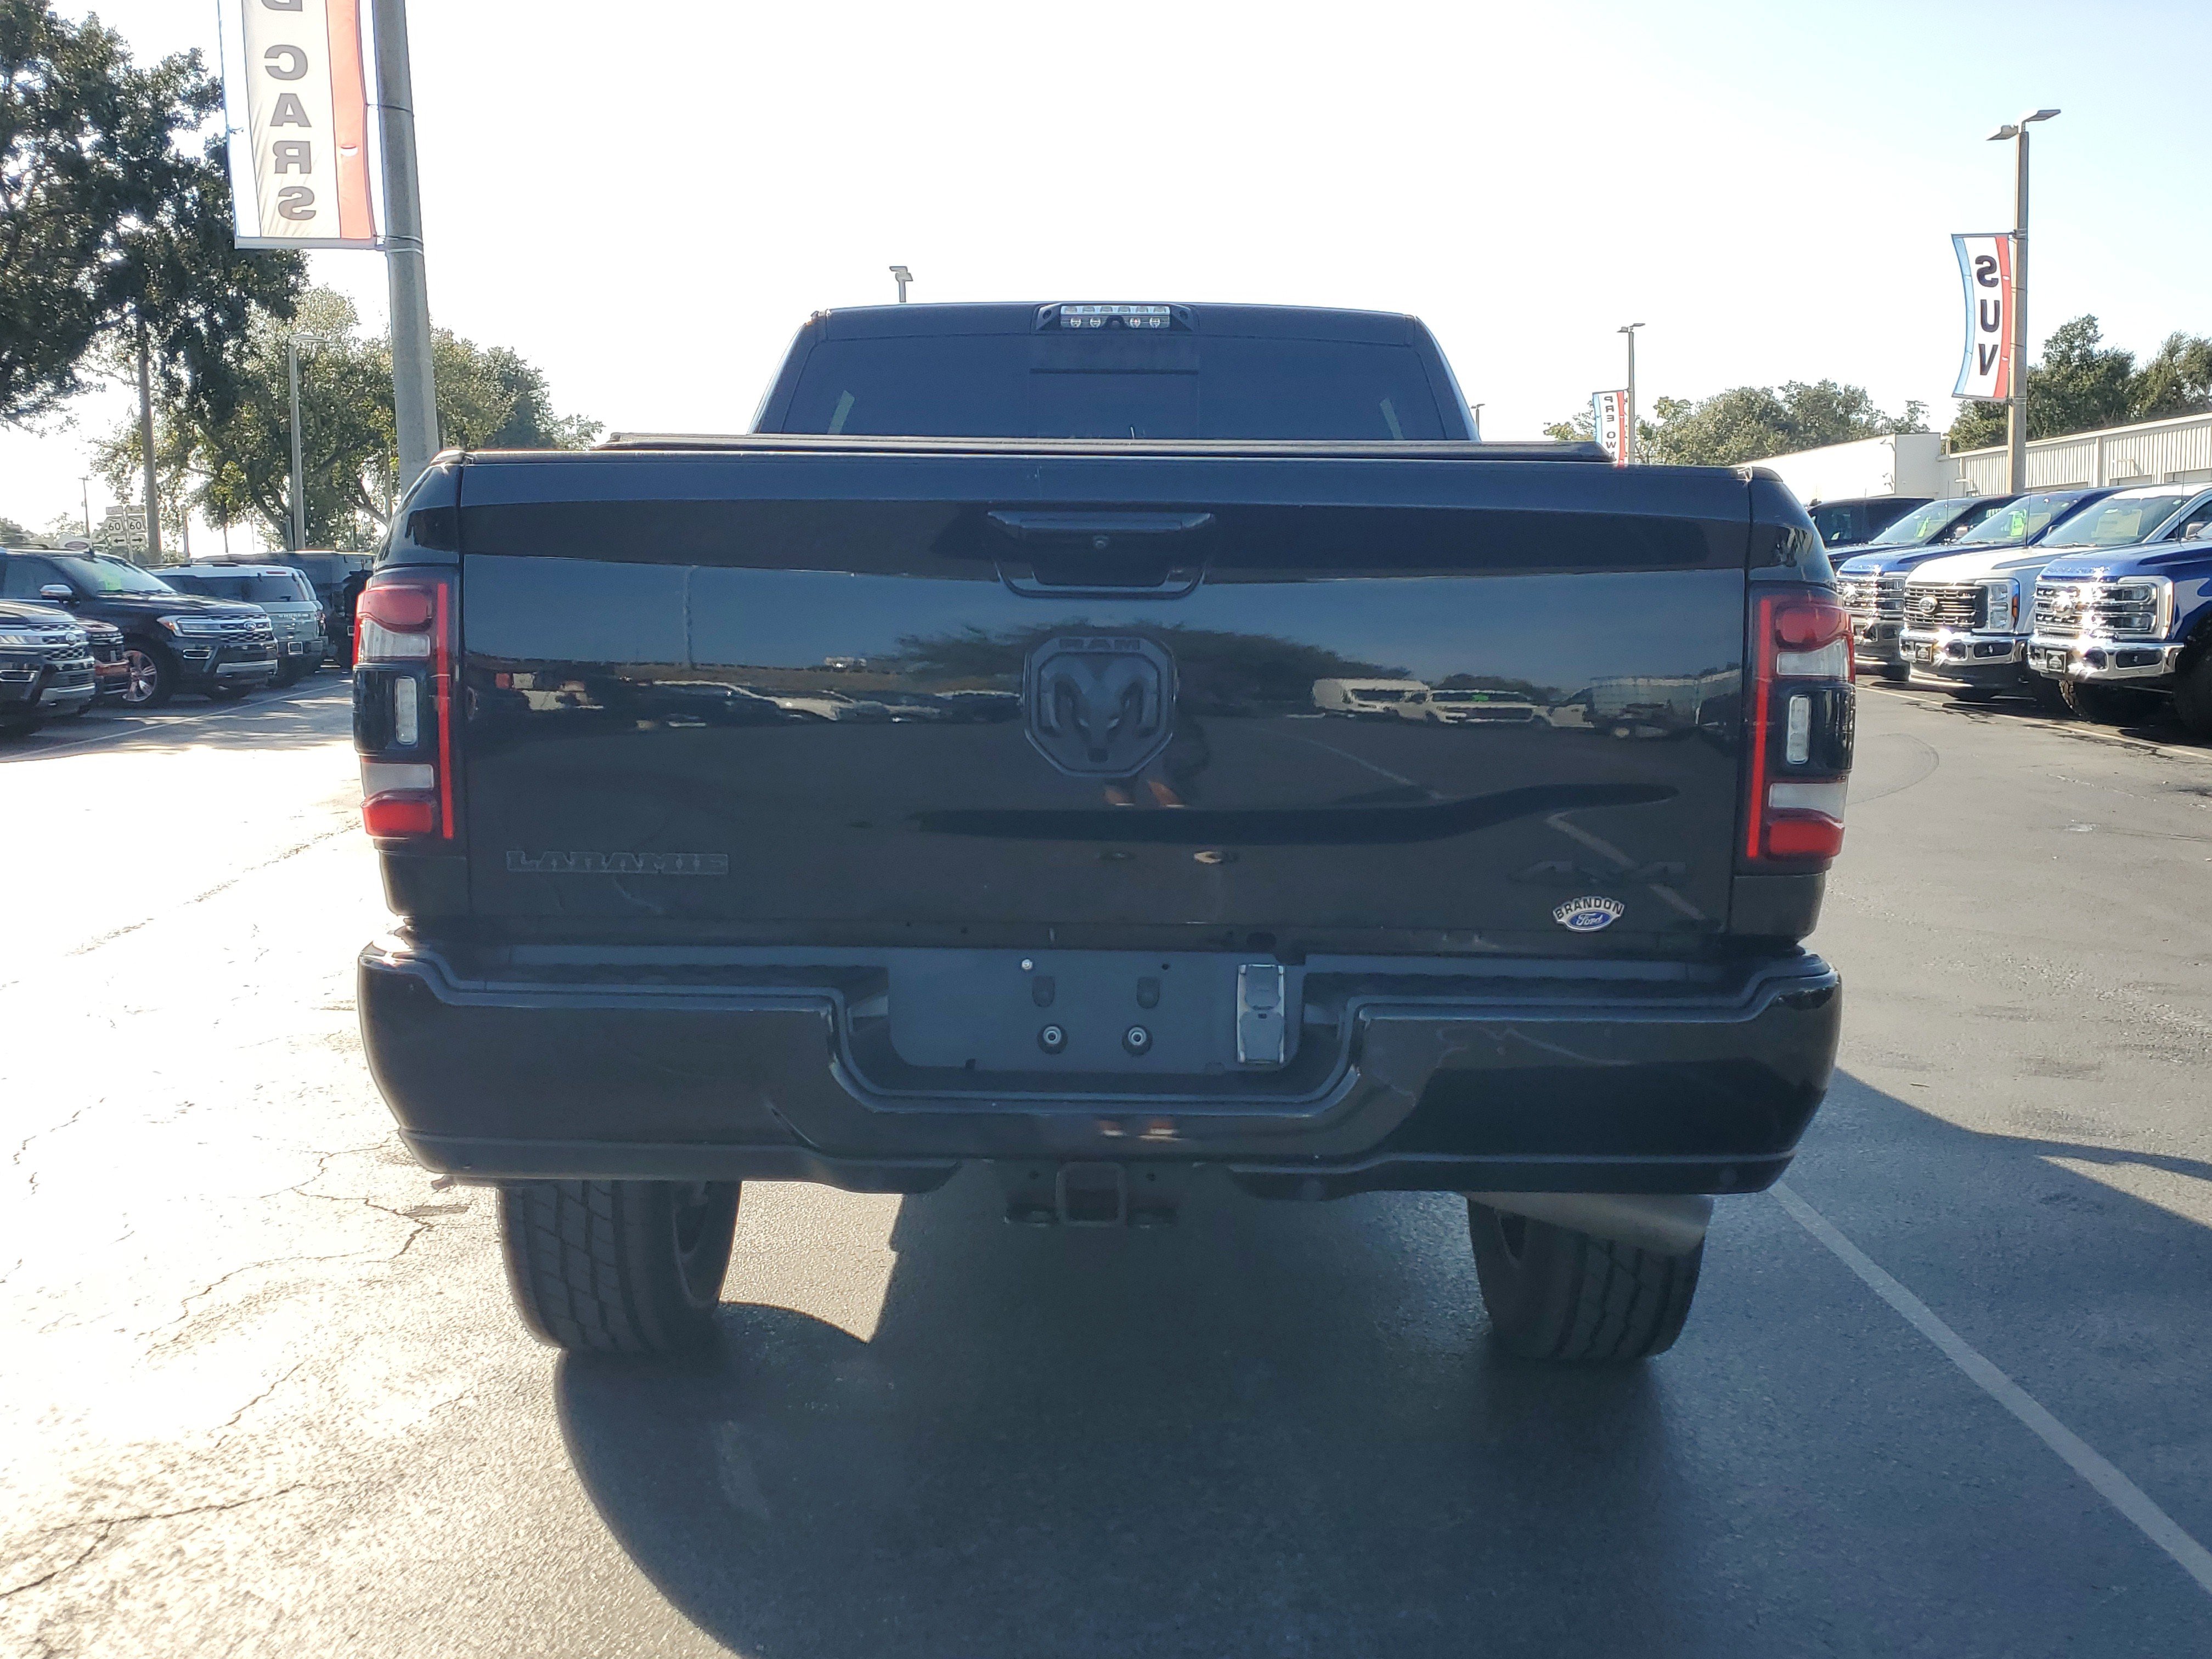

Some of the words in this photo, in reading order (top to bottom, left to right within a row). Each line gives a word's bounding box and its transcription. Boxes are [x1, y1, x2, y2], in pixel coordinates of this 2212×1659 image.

[108, 522, 121, 531] 60
[129, 521, 142, 529] 60
[506, 850, 729, 875] LARAMIE
[1555, 898, 1624, 919] BRANDON
[1576, 913, 1604, 926] Ford
